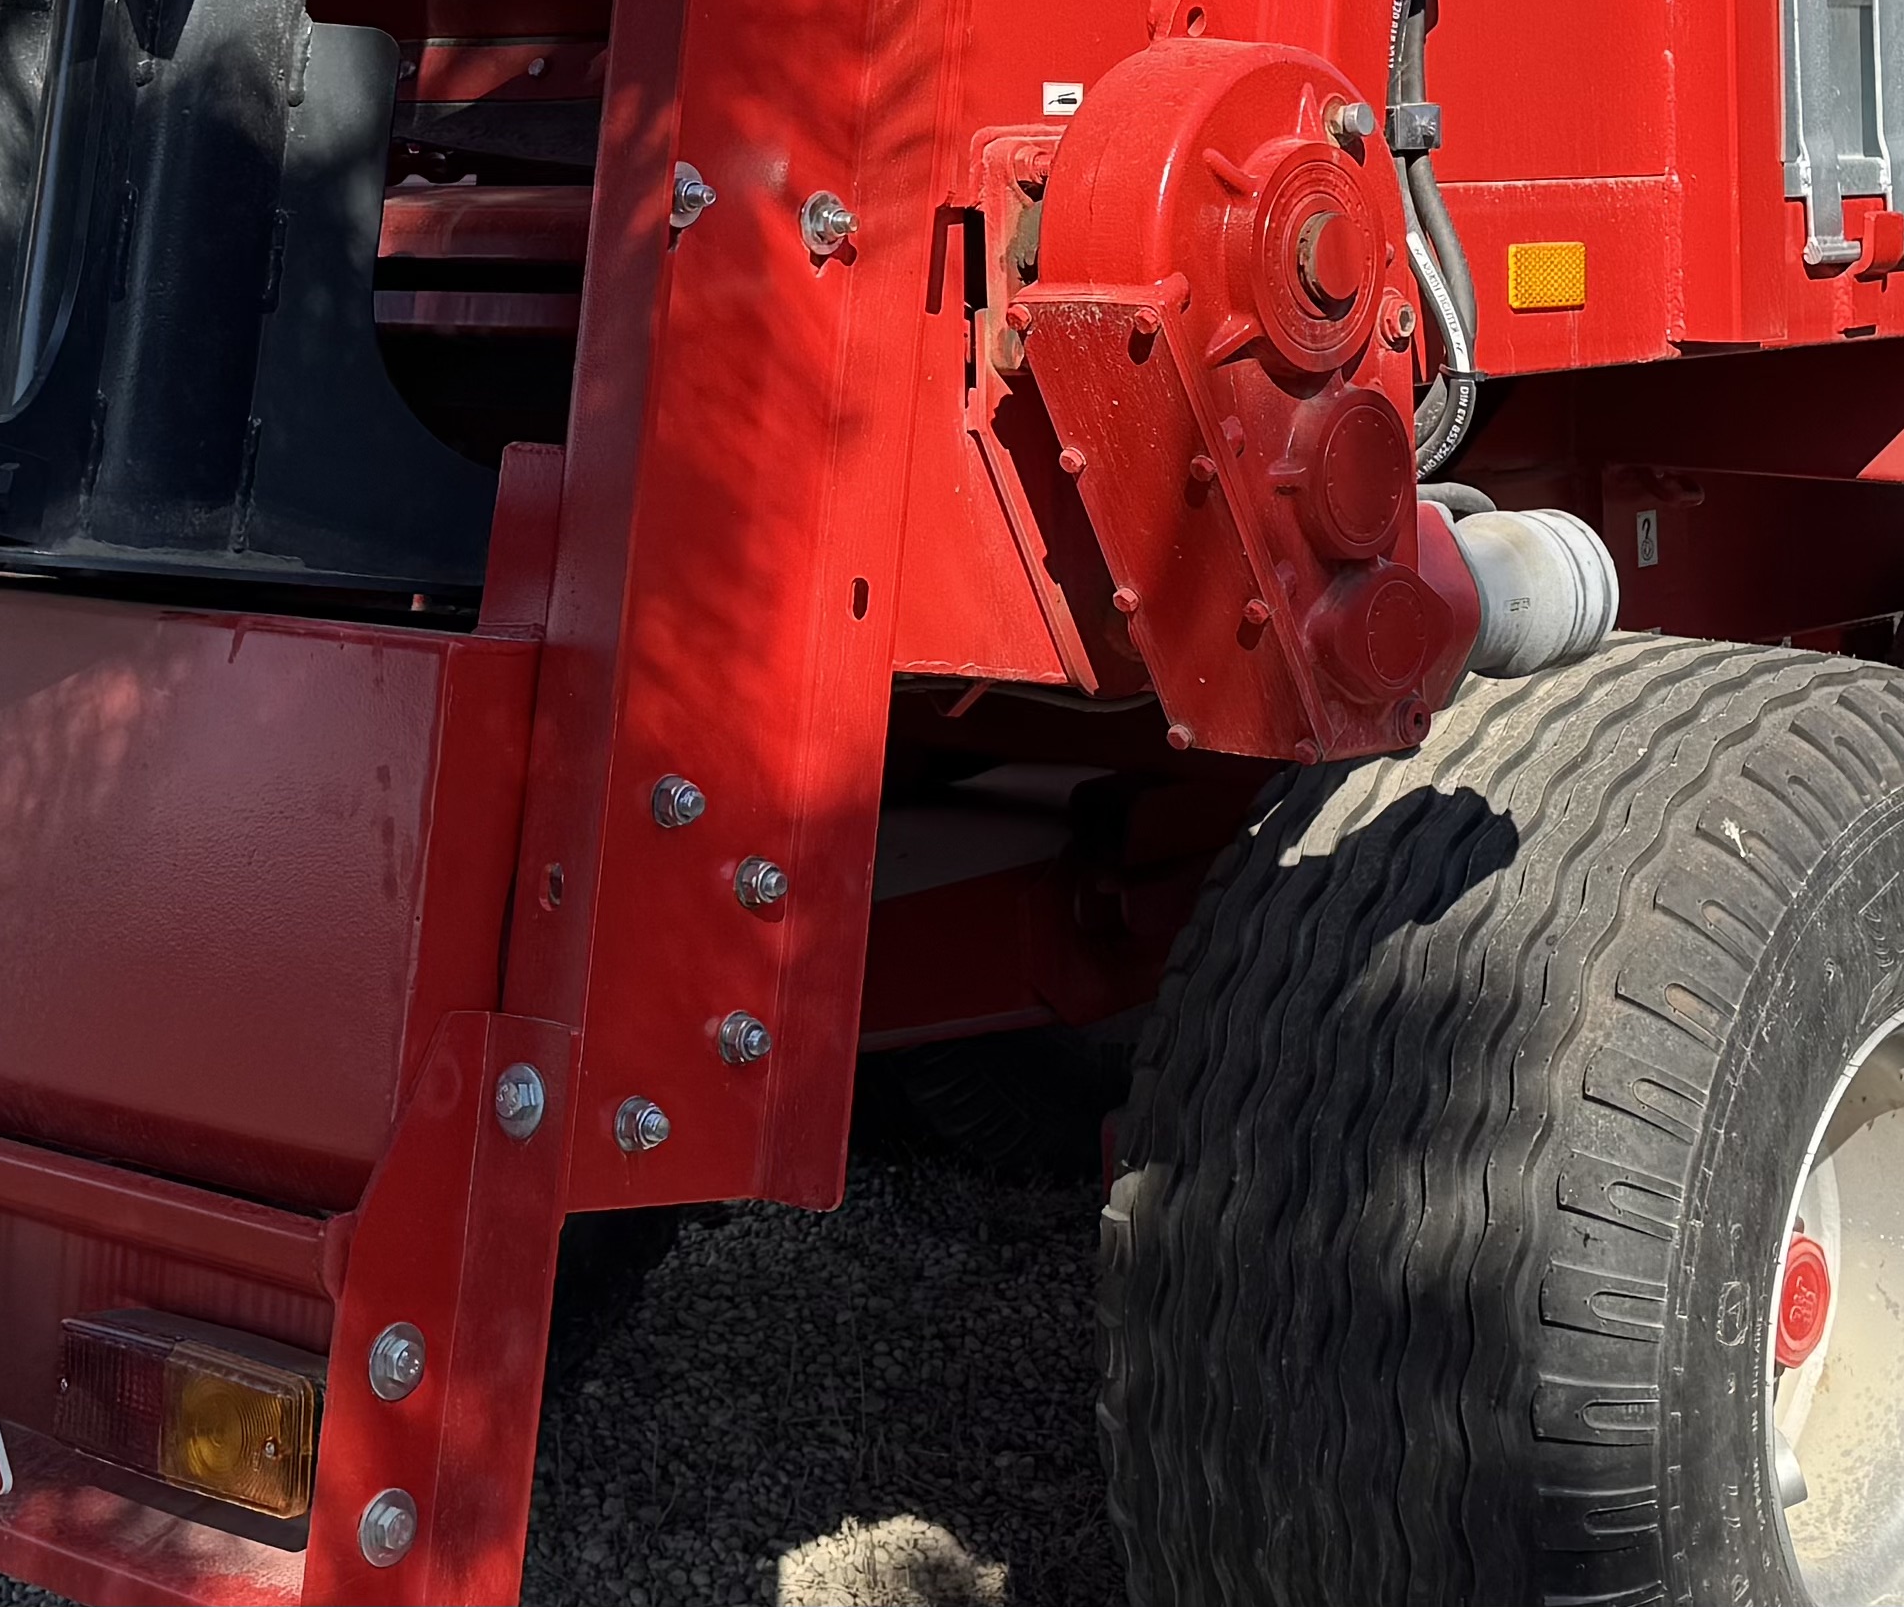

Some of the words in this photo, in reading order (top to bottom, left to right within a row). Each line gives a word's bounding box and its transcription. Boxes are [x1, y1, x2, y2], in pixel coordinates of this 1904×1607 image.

[1459, 385, 1470, 407] DIN
[1454, 408, 1466, 425] EN
[1445, 425, 1461, 443] 853
